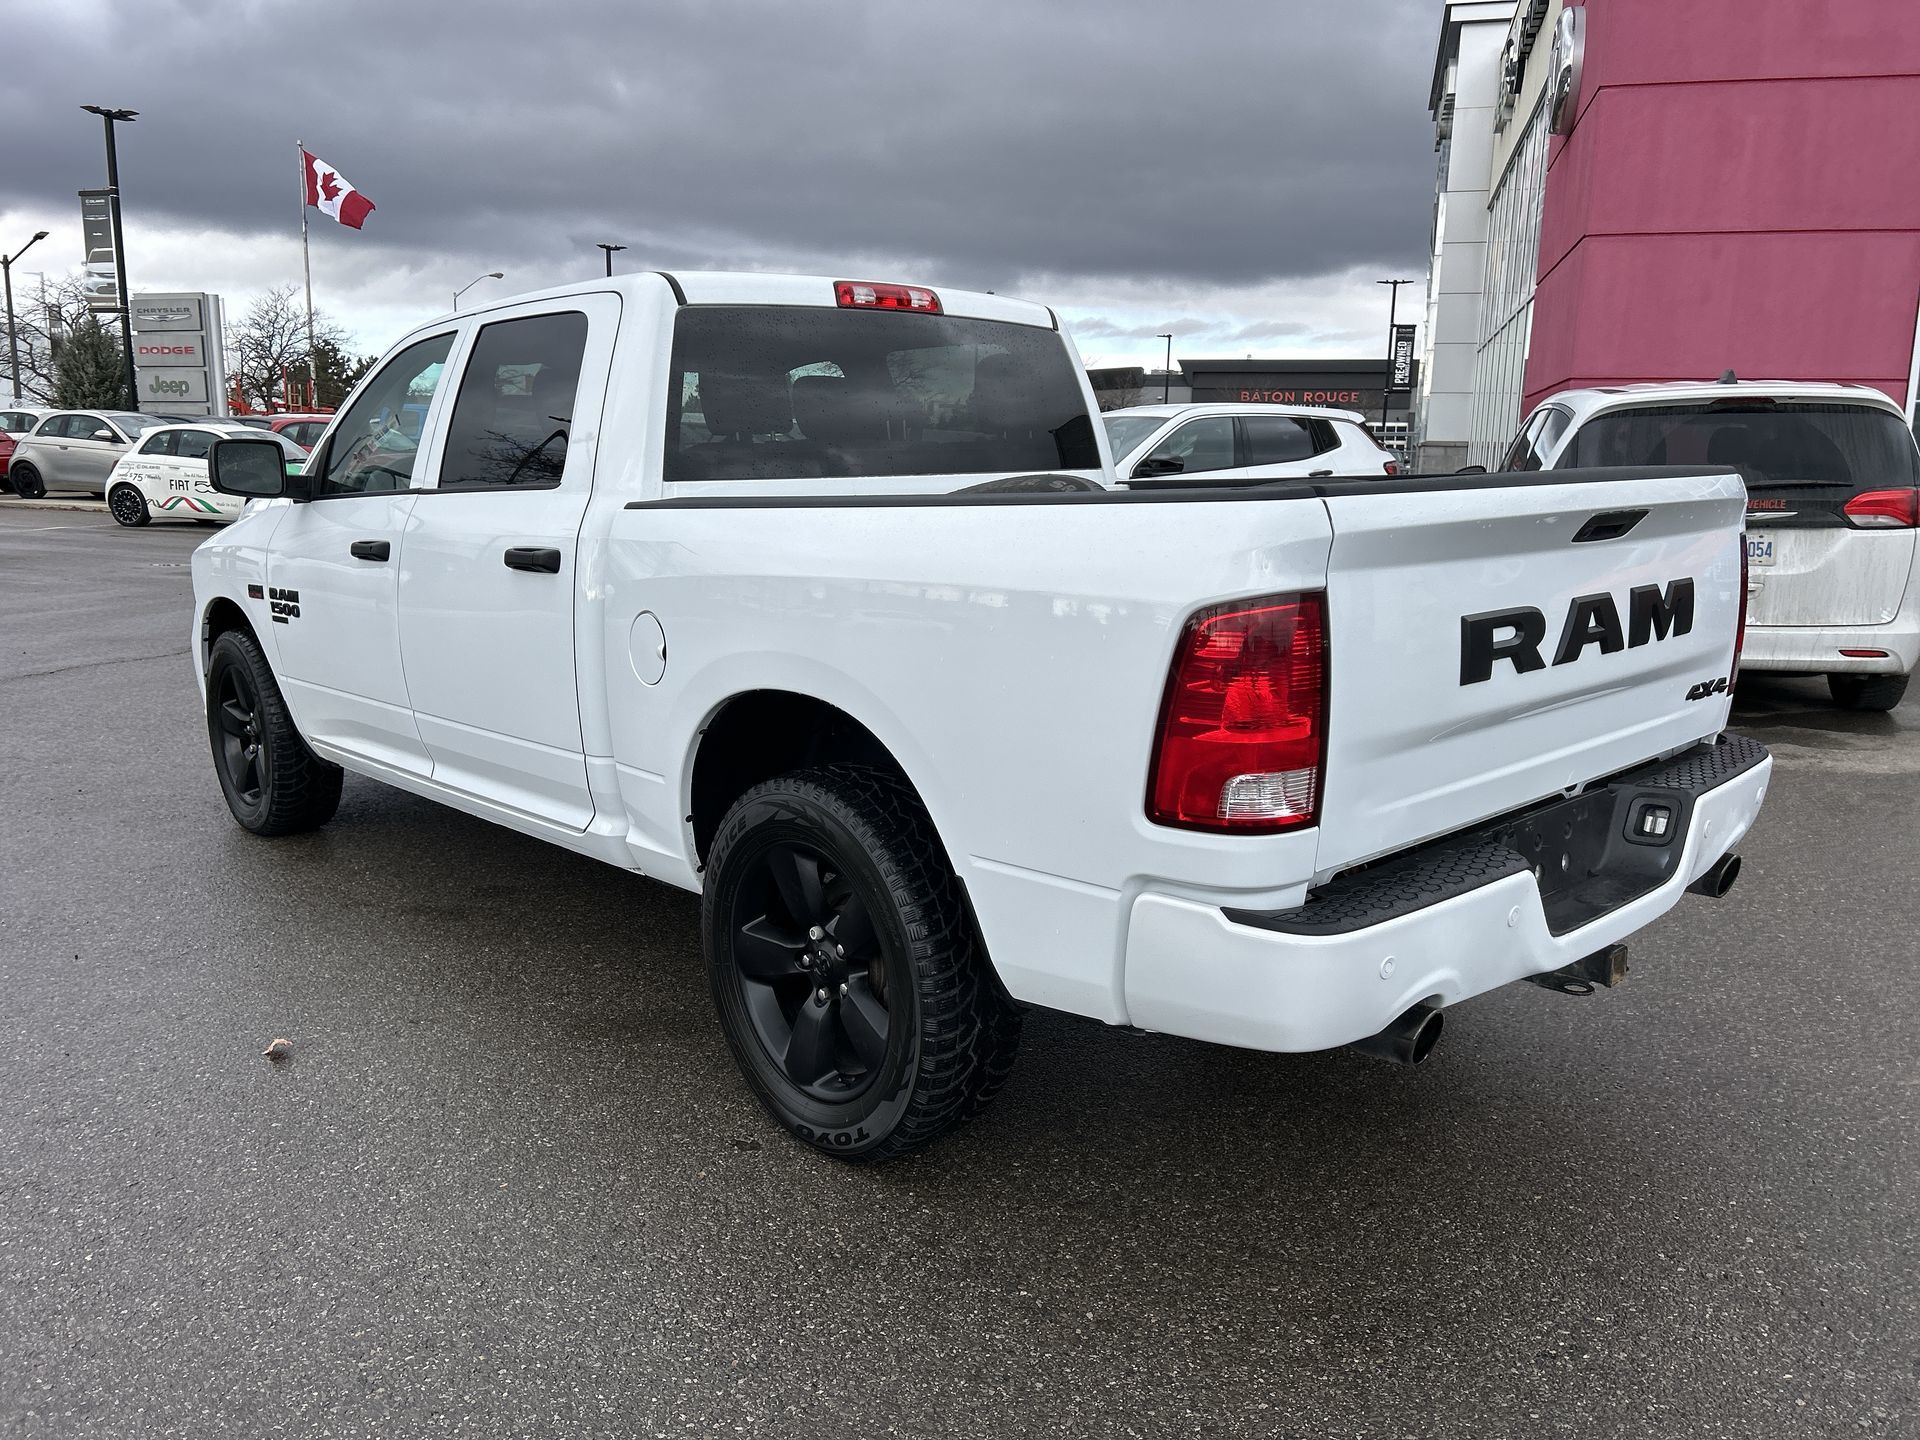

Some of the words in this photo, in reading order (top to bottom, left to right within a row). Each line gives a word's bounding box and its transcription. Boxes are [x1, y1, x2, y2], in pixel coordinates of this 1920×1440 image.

[139, 346, 195, 355] DODGE
[1394, 341, 1407, 384] PRE-OWNED
[149, 375, 190, 397] Jeep
[1303, 391, 1360, 402] ROUGE
[169, 479, 189, 491] FIAT
[1748, 499, 1786, 509] VEHICLE
[269, 587, 299, 603] RAM
[270, 601, 301, 618] 1500
[1460, 576, 1695, 687] RAM
[796, 1124, 870, 1146] TOYO
